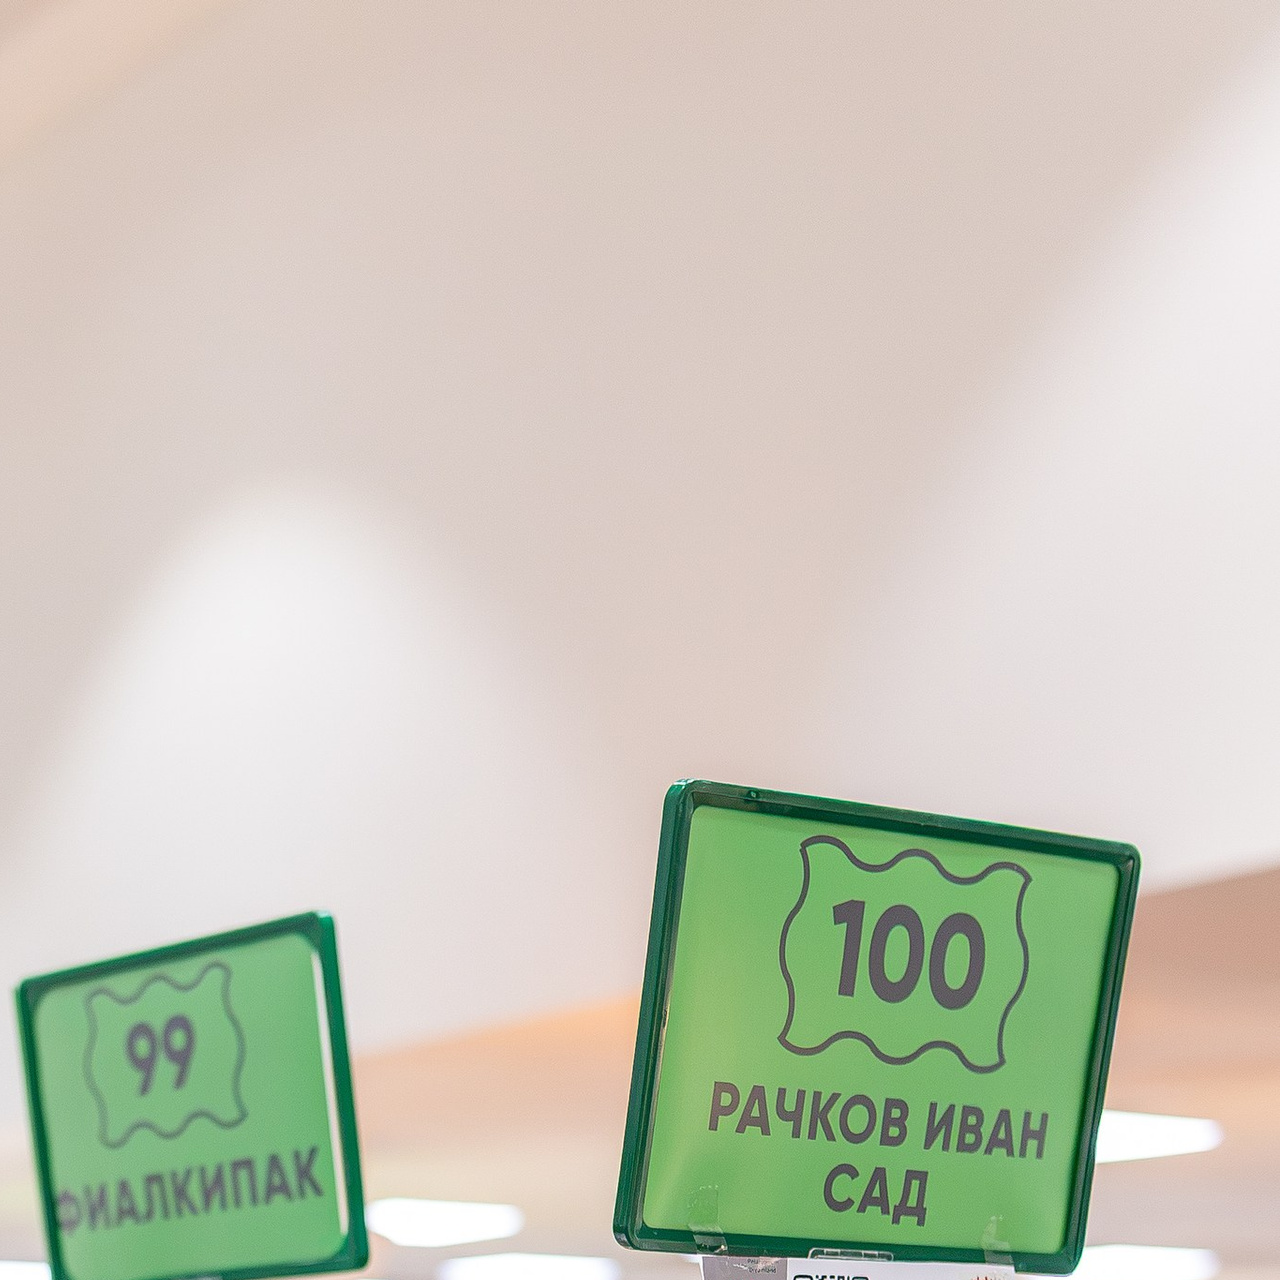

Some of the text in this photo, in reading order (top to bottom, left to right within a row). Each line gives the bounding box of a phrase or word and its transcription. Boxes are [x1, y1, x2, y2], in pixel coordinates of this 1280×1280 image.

[832, 899, 986, 1011] 100
[124, 1014, 196, 1096] 99
[708, 1081, 1049, 1160] РАЧКОВ ИВАН
[823, 1163, 929, 1227] САД
